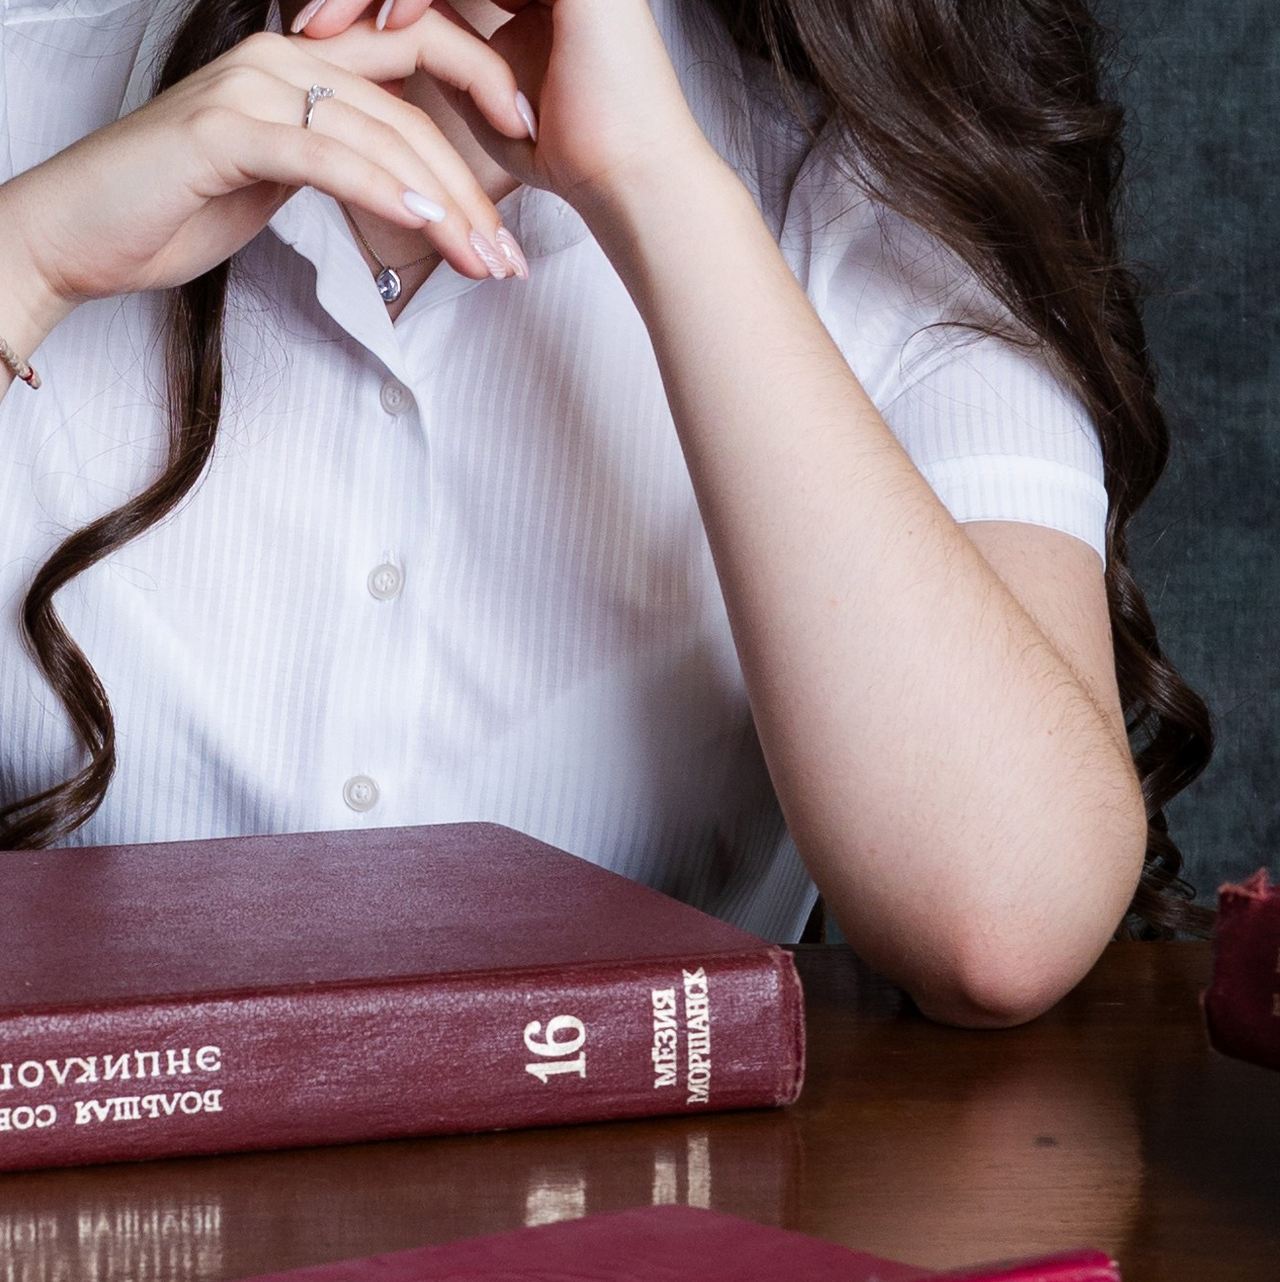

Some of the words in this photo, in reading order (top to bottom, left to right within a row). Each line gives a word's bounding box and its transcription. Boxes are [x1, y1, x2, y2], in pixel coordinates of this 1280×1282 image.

[523, 1014, 587, 1084] 16
[682, 966, 712, 1105] МОРШАНСК
[74, 1089, 223, 1125] БОЛЬШАЯ
